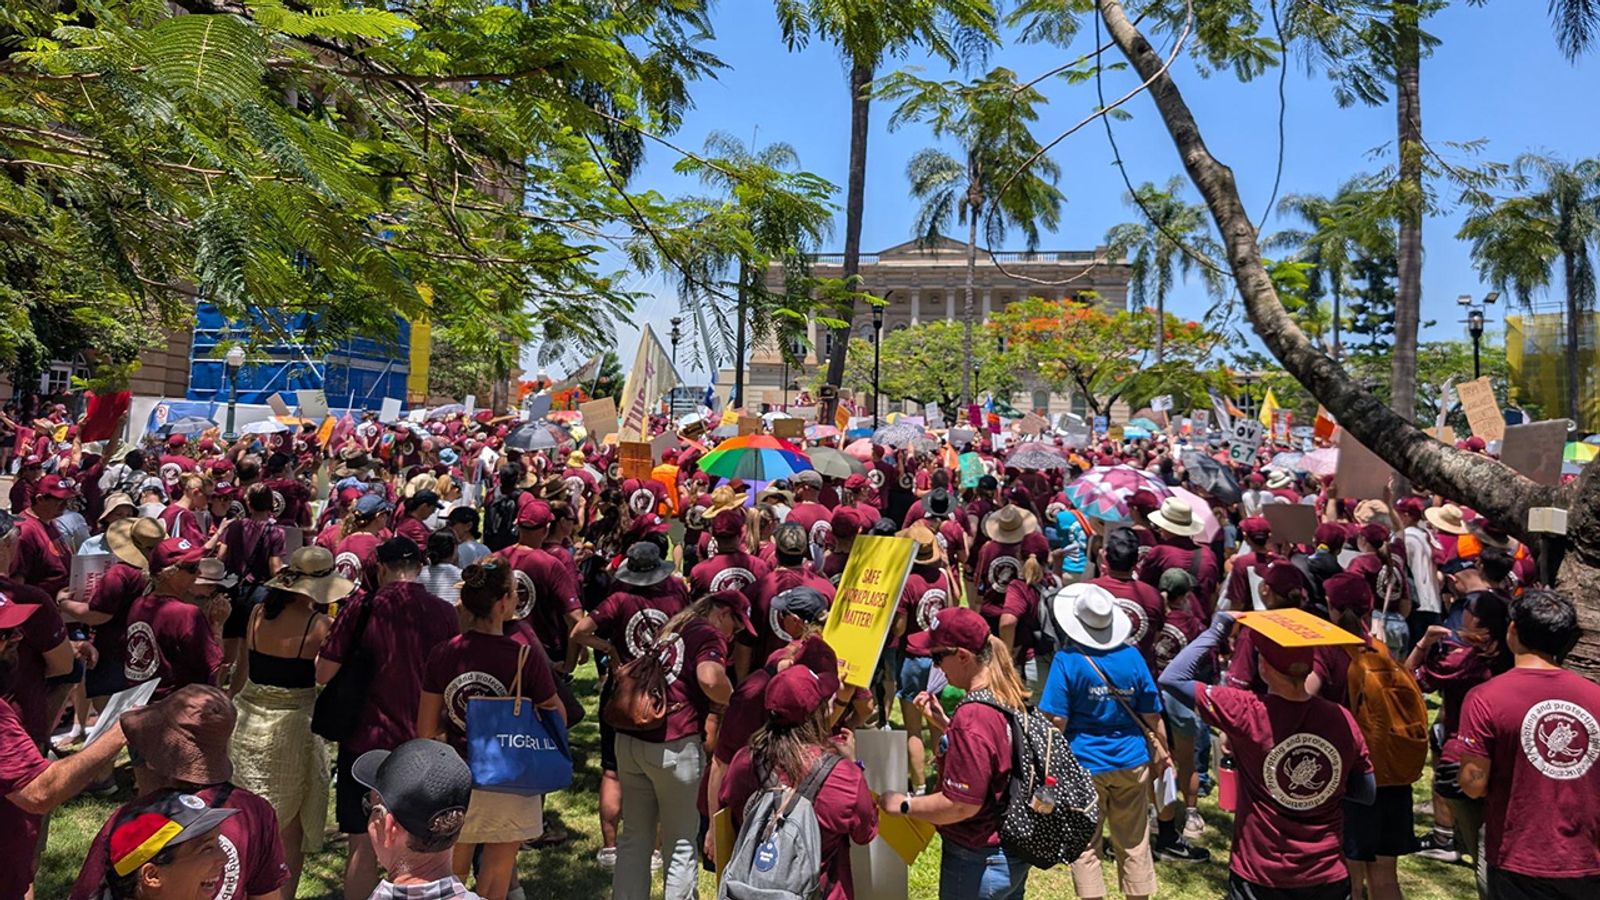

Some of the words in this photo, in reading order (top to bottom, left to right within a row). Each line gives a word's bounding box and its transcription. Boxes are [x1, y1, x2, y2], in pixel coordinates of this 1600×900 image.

[862, 568, 882, 585] SAFE
[843, 588, 889, 608] WORKPLACES
[842, 610, 873, 628] MATTER!
[458, 674, 473, 685] and
[1536, 702, 1552, 714] and
[1554, 702, 1599, 735] protecting
[496, 734, 559, 751] TIGERLIL
[1266, 746, 1286, 790] Promoting
[1286, 735, 1301, 747] and
[1302, 736, 1340, 766] protecting
